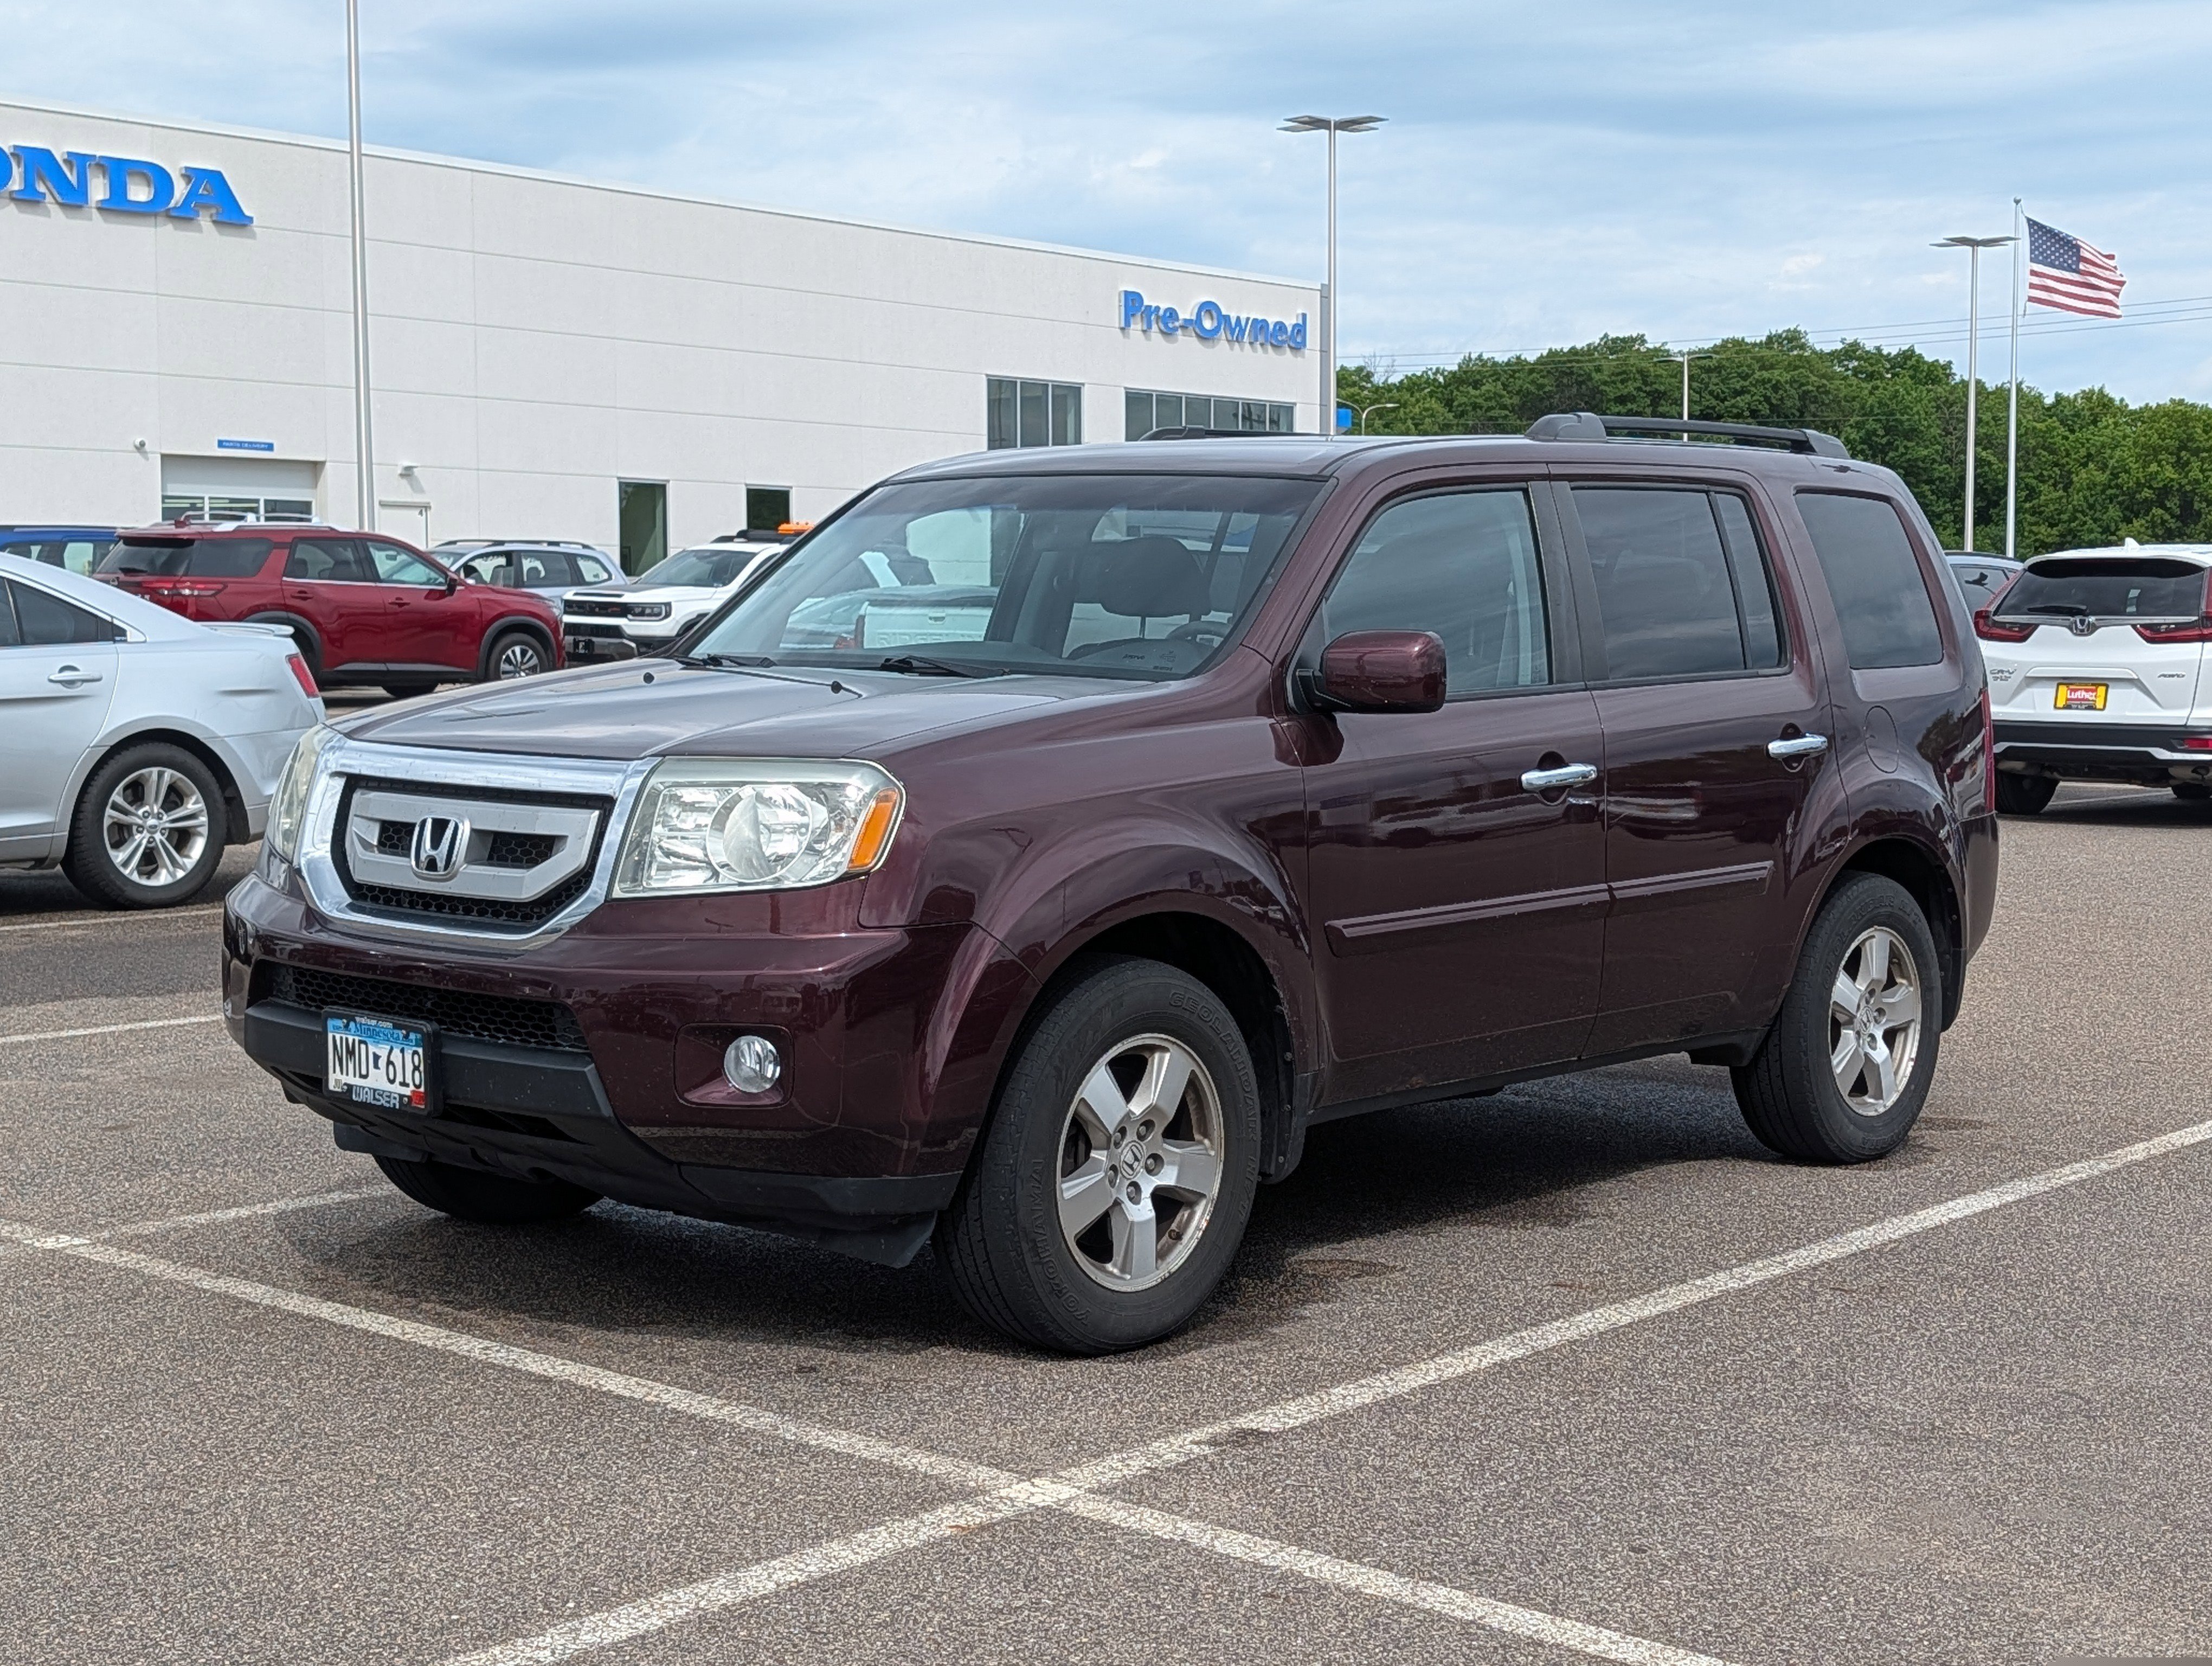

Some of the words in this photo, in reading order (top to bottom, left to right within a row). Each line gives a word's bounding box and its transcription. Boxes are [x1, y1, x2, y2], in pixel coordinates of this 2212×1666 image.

[0, 145, 254, 225] NDA
[1120, 290, 1307, 350] Pre-Owned
[2067, 690, 2097, 700] Luther
[353, 1085, 400, 1109] WALSER
[1028, 1158, 1092, 1327] YOKOHAMA
